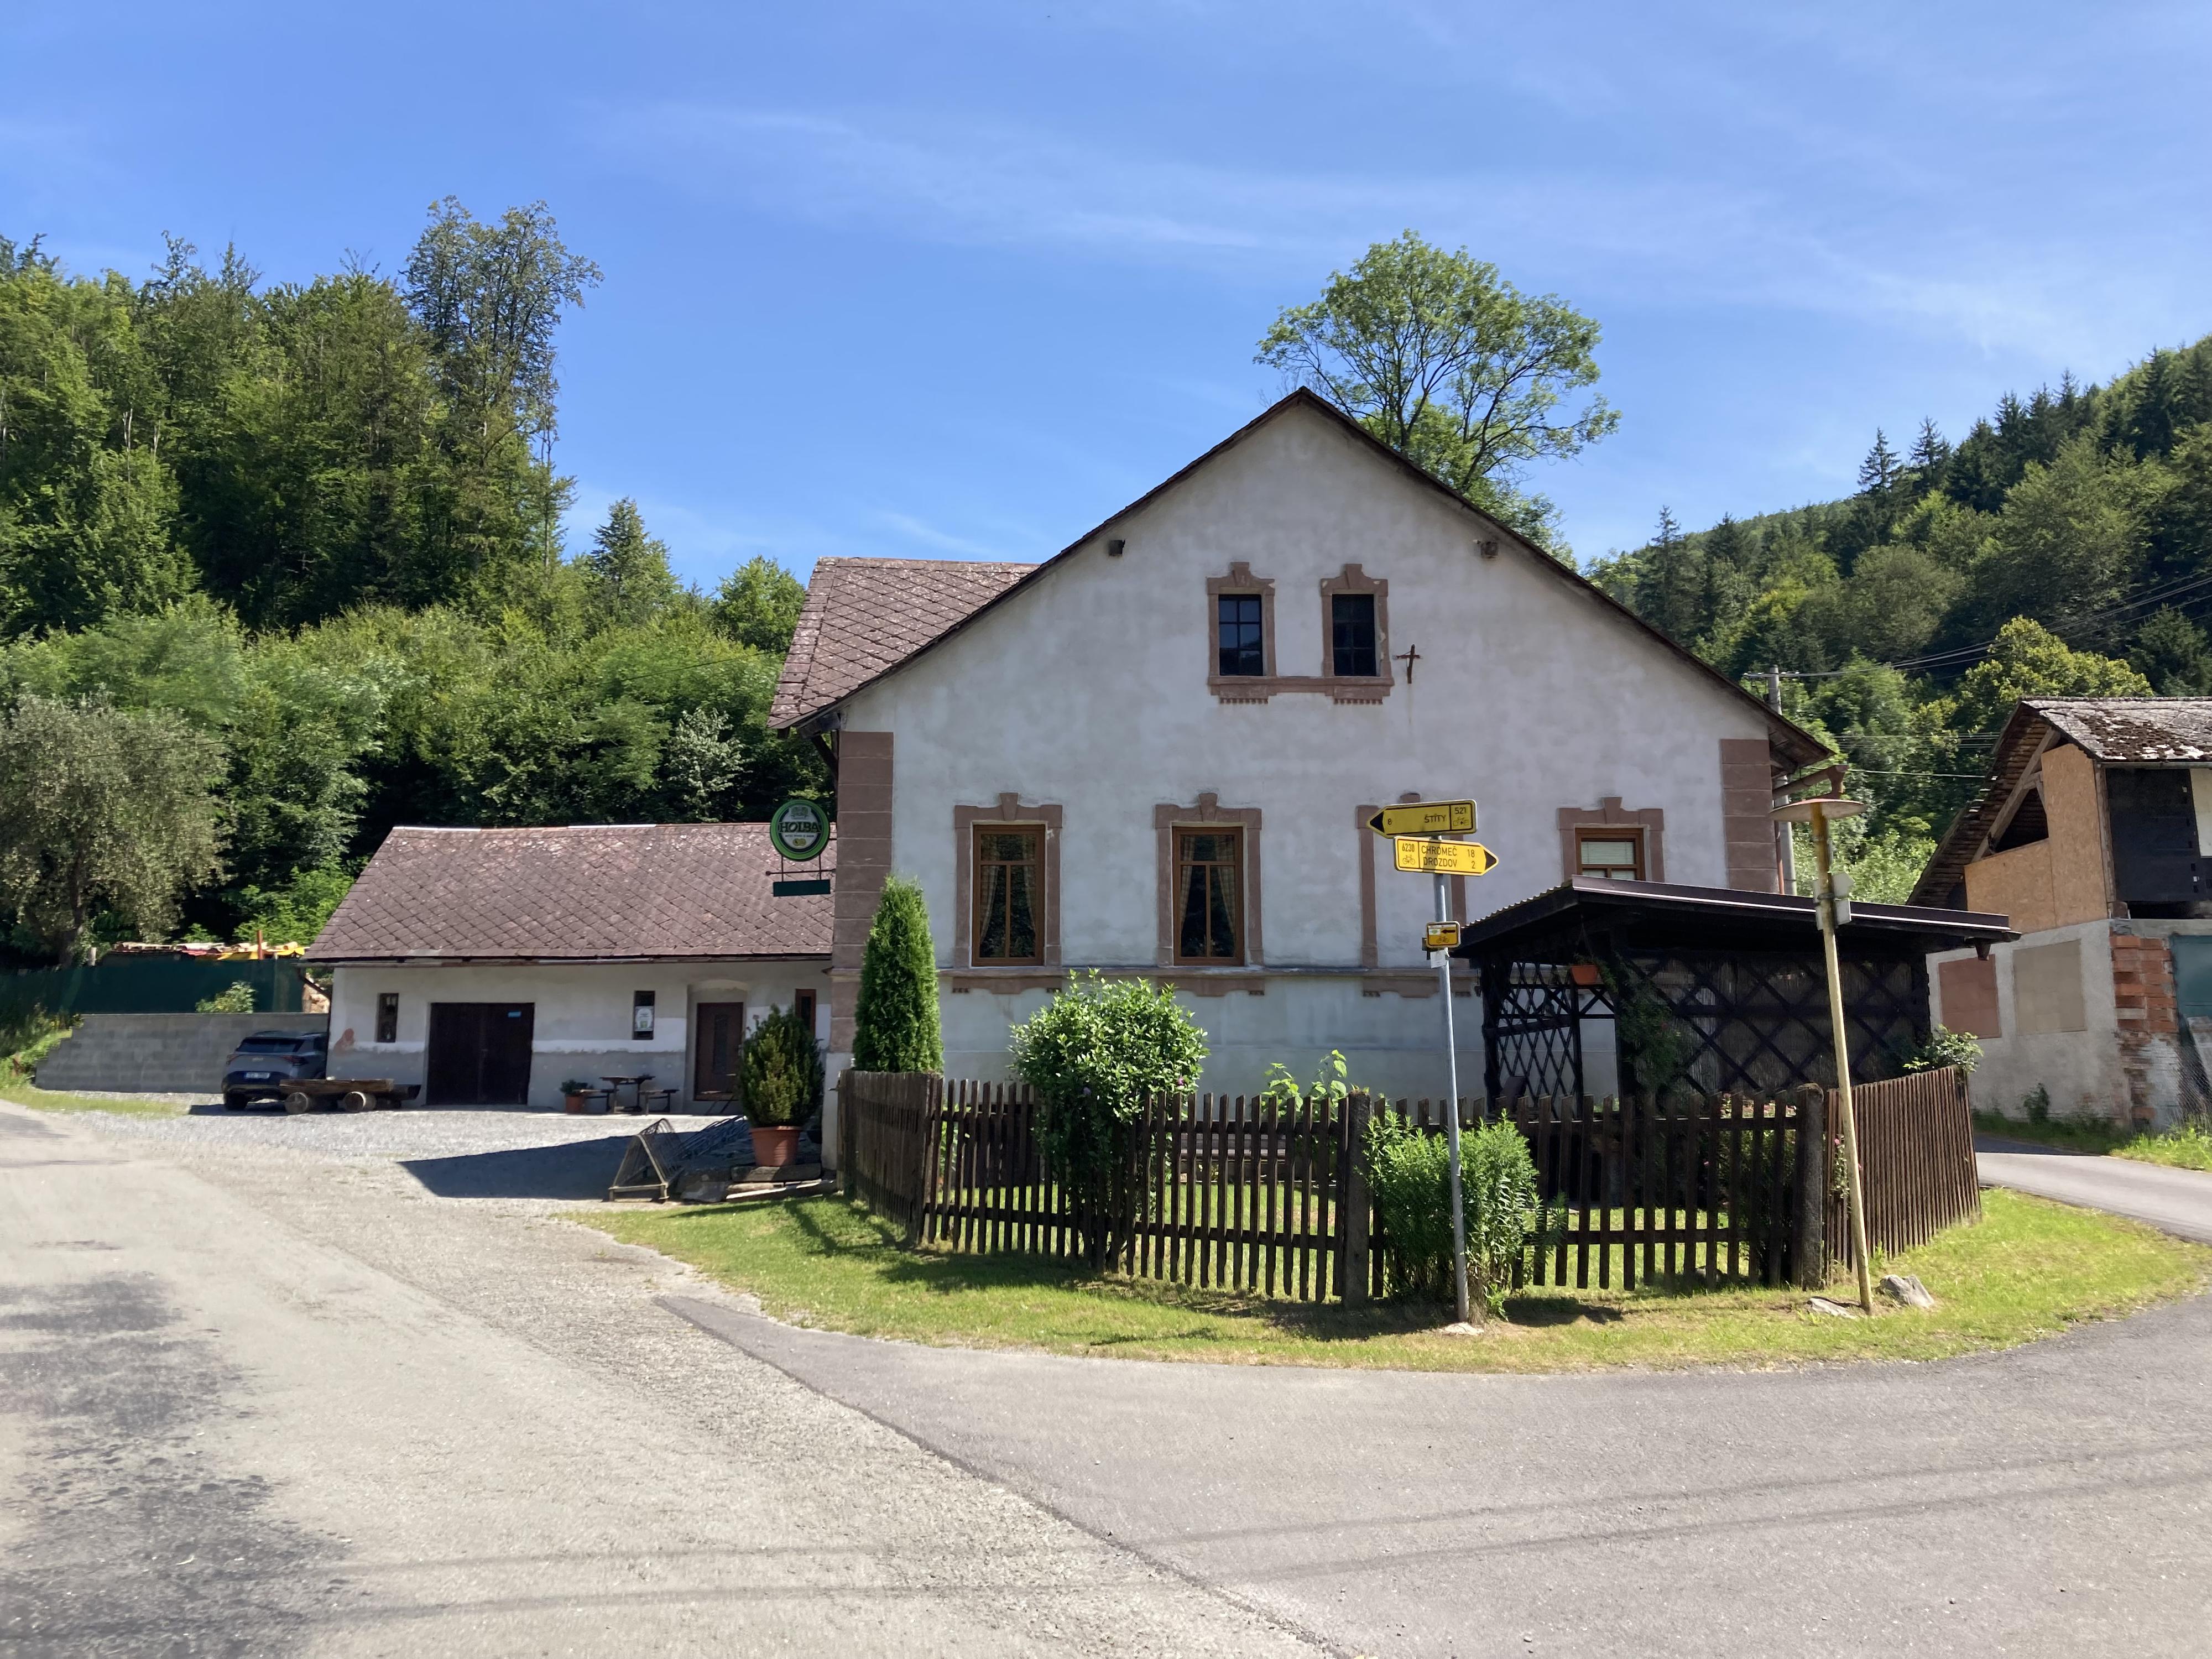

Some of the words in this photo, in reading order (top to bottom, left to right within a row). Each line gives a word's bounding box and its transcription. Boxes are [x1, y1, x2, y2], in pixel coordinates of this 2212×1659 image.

[1424, 813, 1446, 823] ŠTÍTY
[779, 822, 821, 832] HOLBA
[1402, 843, 1415, 852] 6230
[1421, 846, 1457, 856] CHROMEČ
[1467, 849, 1475, 857] 18
[1423, 857, 1457, 867] DROZDOV
[1471, 860, 1475, 869] 2
